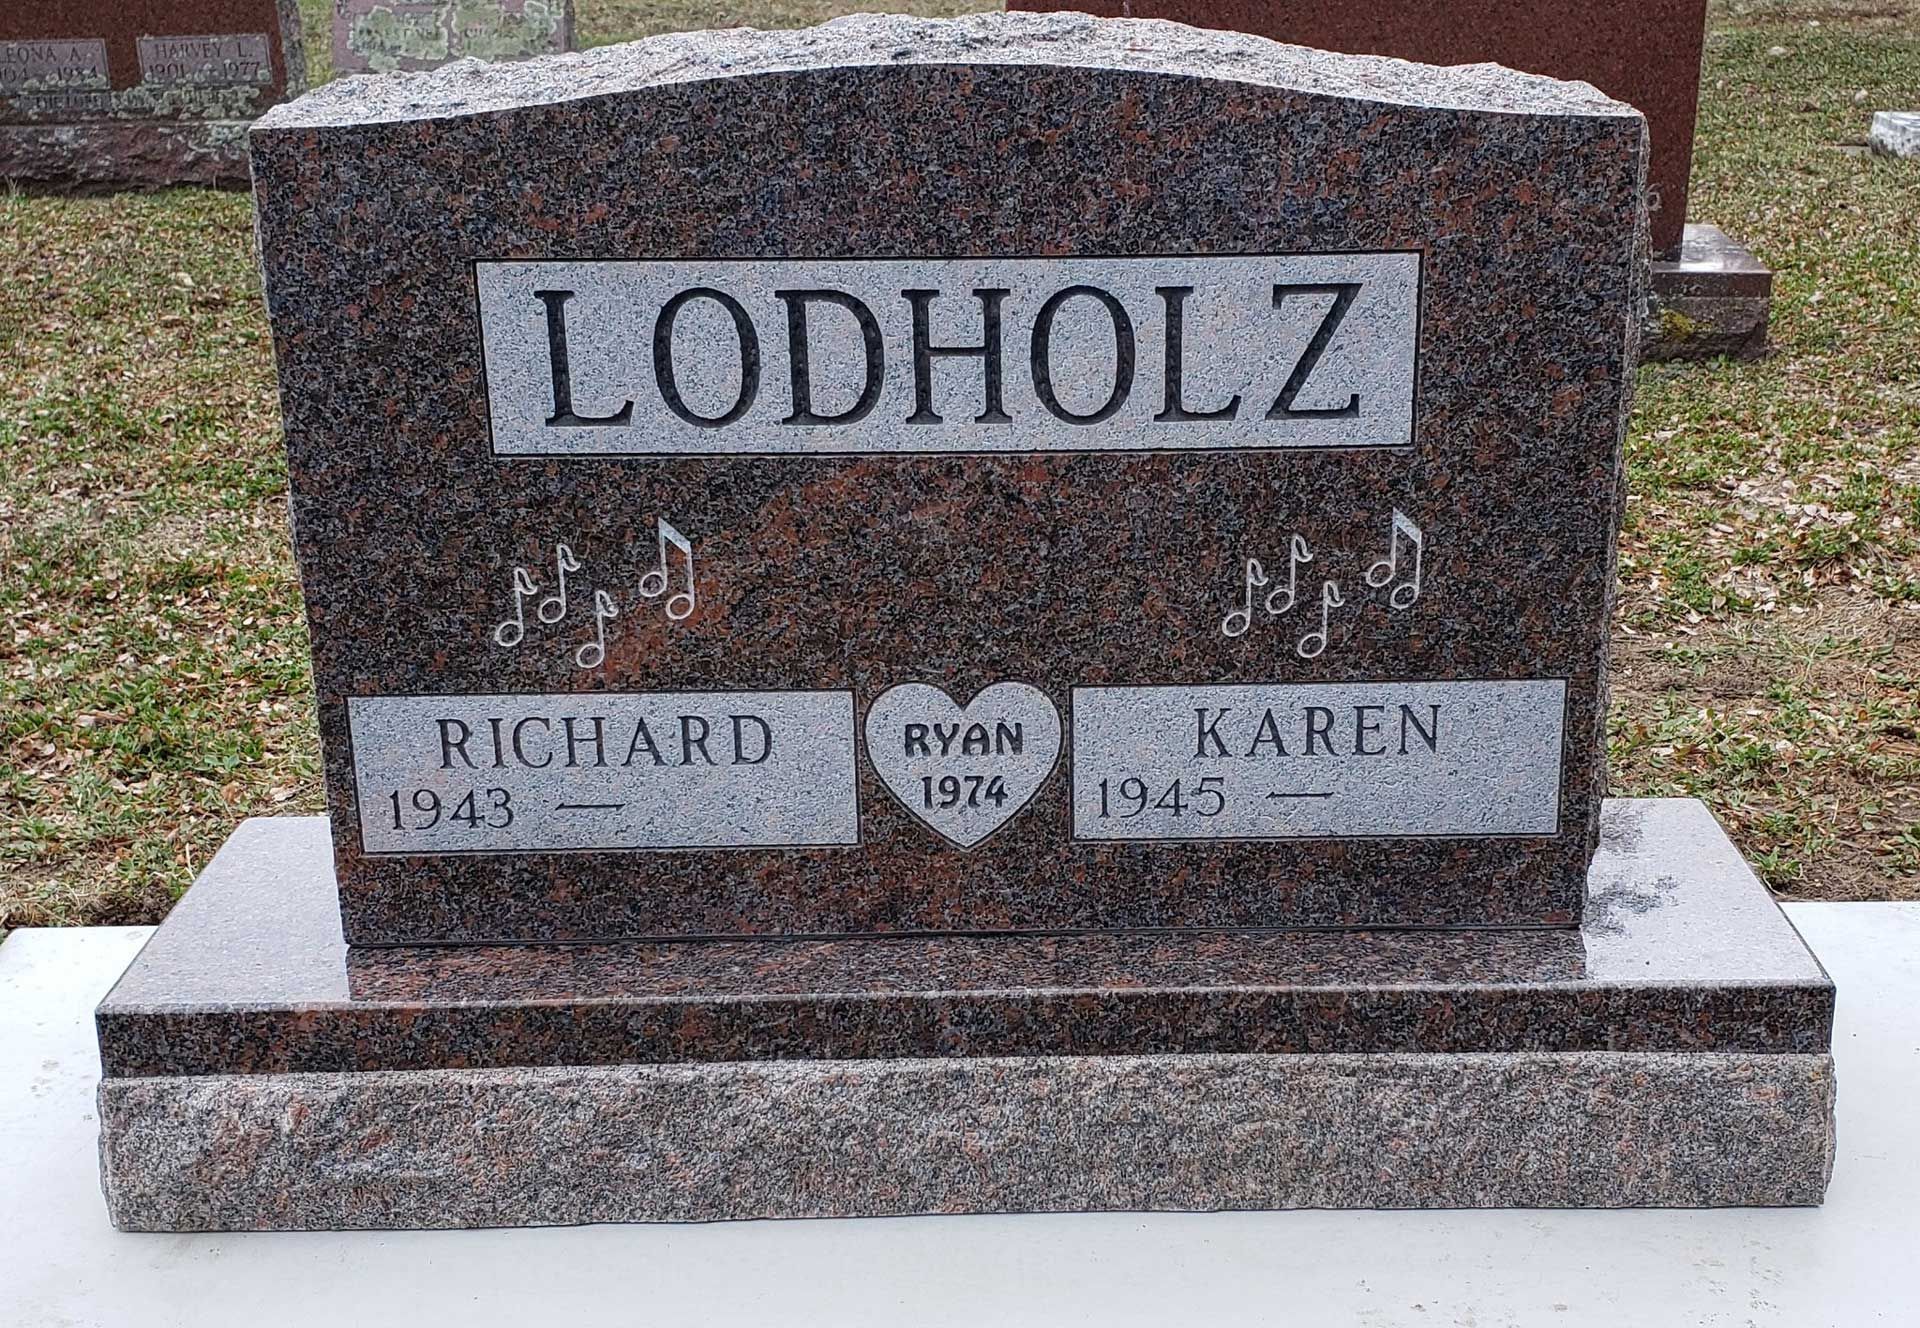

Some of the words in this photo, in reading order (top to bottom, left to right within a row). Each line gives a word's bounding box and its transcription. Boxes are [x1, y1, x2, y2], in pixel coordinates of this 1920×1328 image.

[223, 61, 261, 80] 1977
[533, 282, 1364, 429] LODHOLZ
[434, 714, 773, 770] RICHARD
[903, 722, 1024, 758] RYAN
[1192, 703, 1444, 760] KAREN
[389, 787, 515, 831] 1943
[921, 774, 1008, 810] 1974
[1098, 775, 1227, 819] 1945
